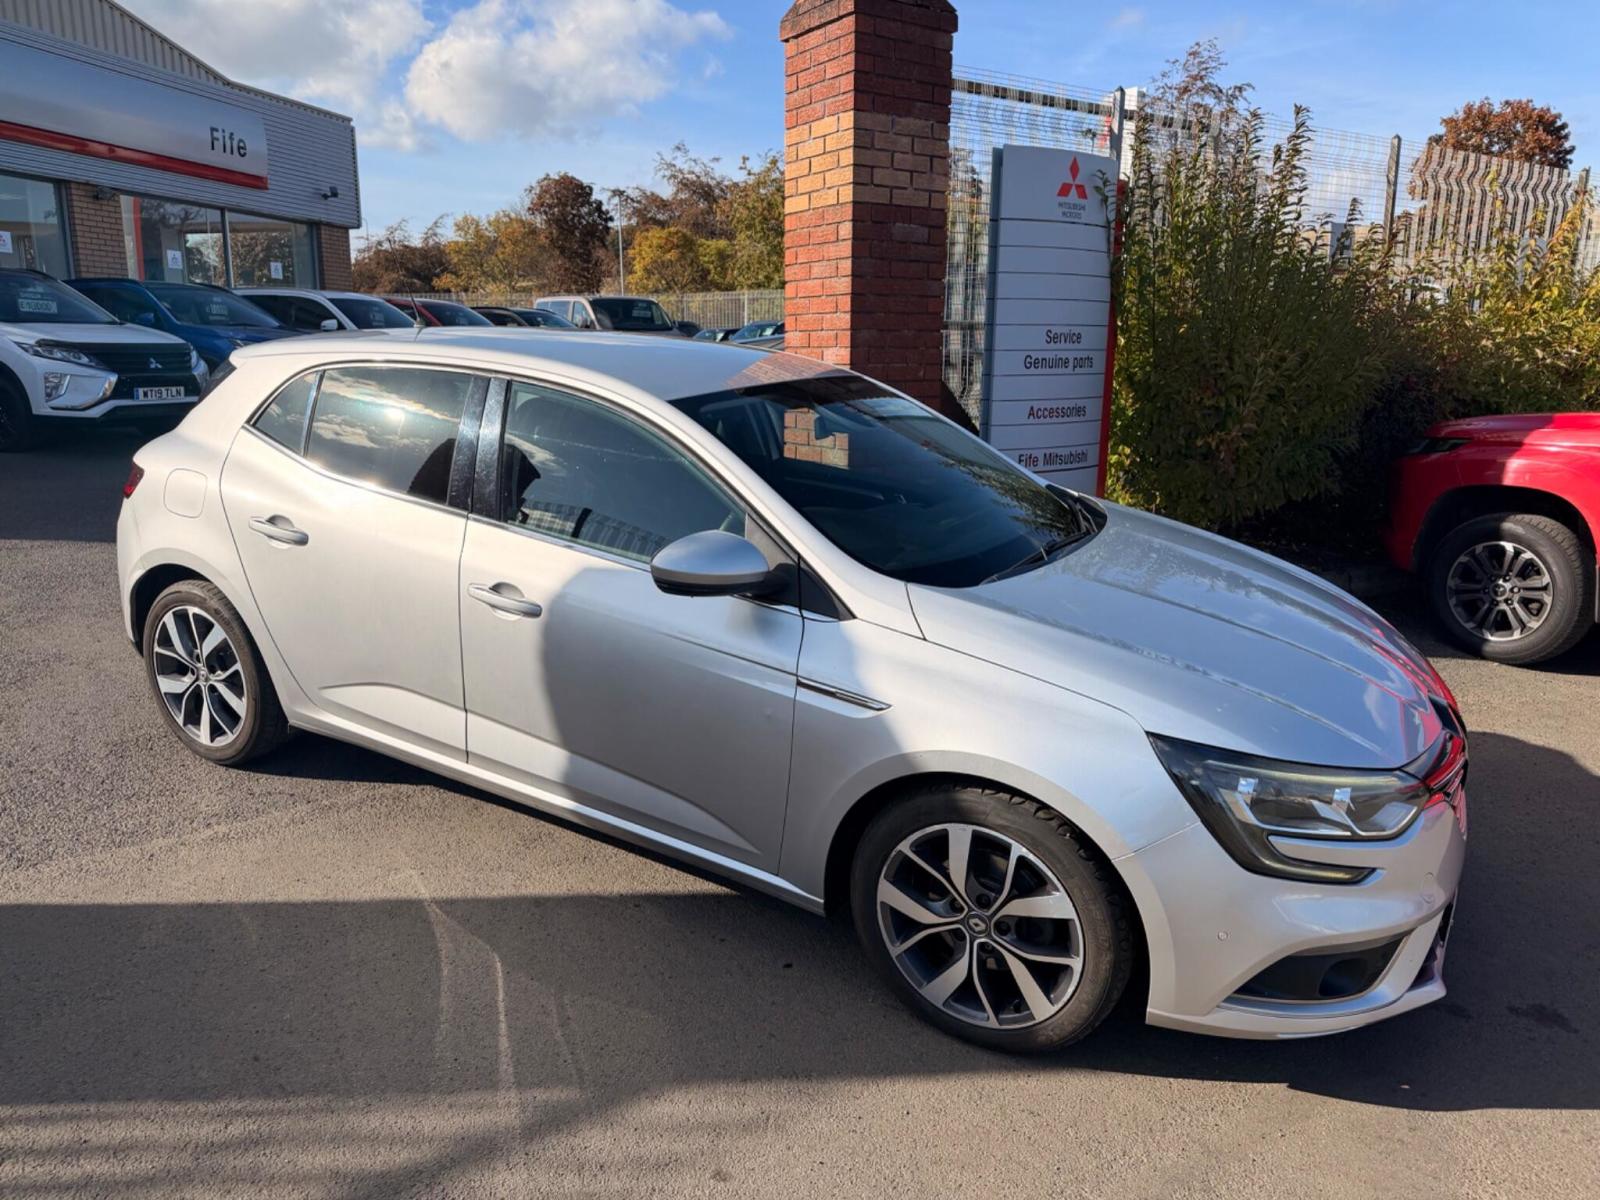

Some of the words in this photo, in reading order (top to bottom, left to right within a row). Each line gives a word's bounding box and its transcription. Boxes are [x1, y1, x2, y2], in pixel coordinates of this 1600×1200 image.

[209, 126, 247, 158] Fife
[1045, 329, 1082, 344] Service
[1024, 354, 1069, 369] Genuine
[1073, 355, 1093, 371] parts
[142, 388, 163, 399] WT19
[164, 387, 182, 398] TLN
[1027, 404, 1087, 420] Accessories
[1018, 453, 1039, 468] Fife
[1043, 450, 1088, 467] Mitsubishi
